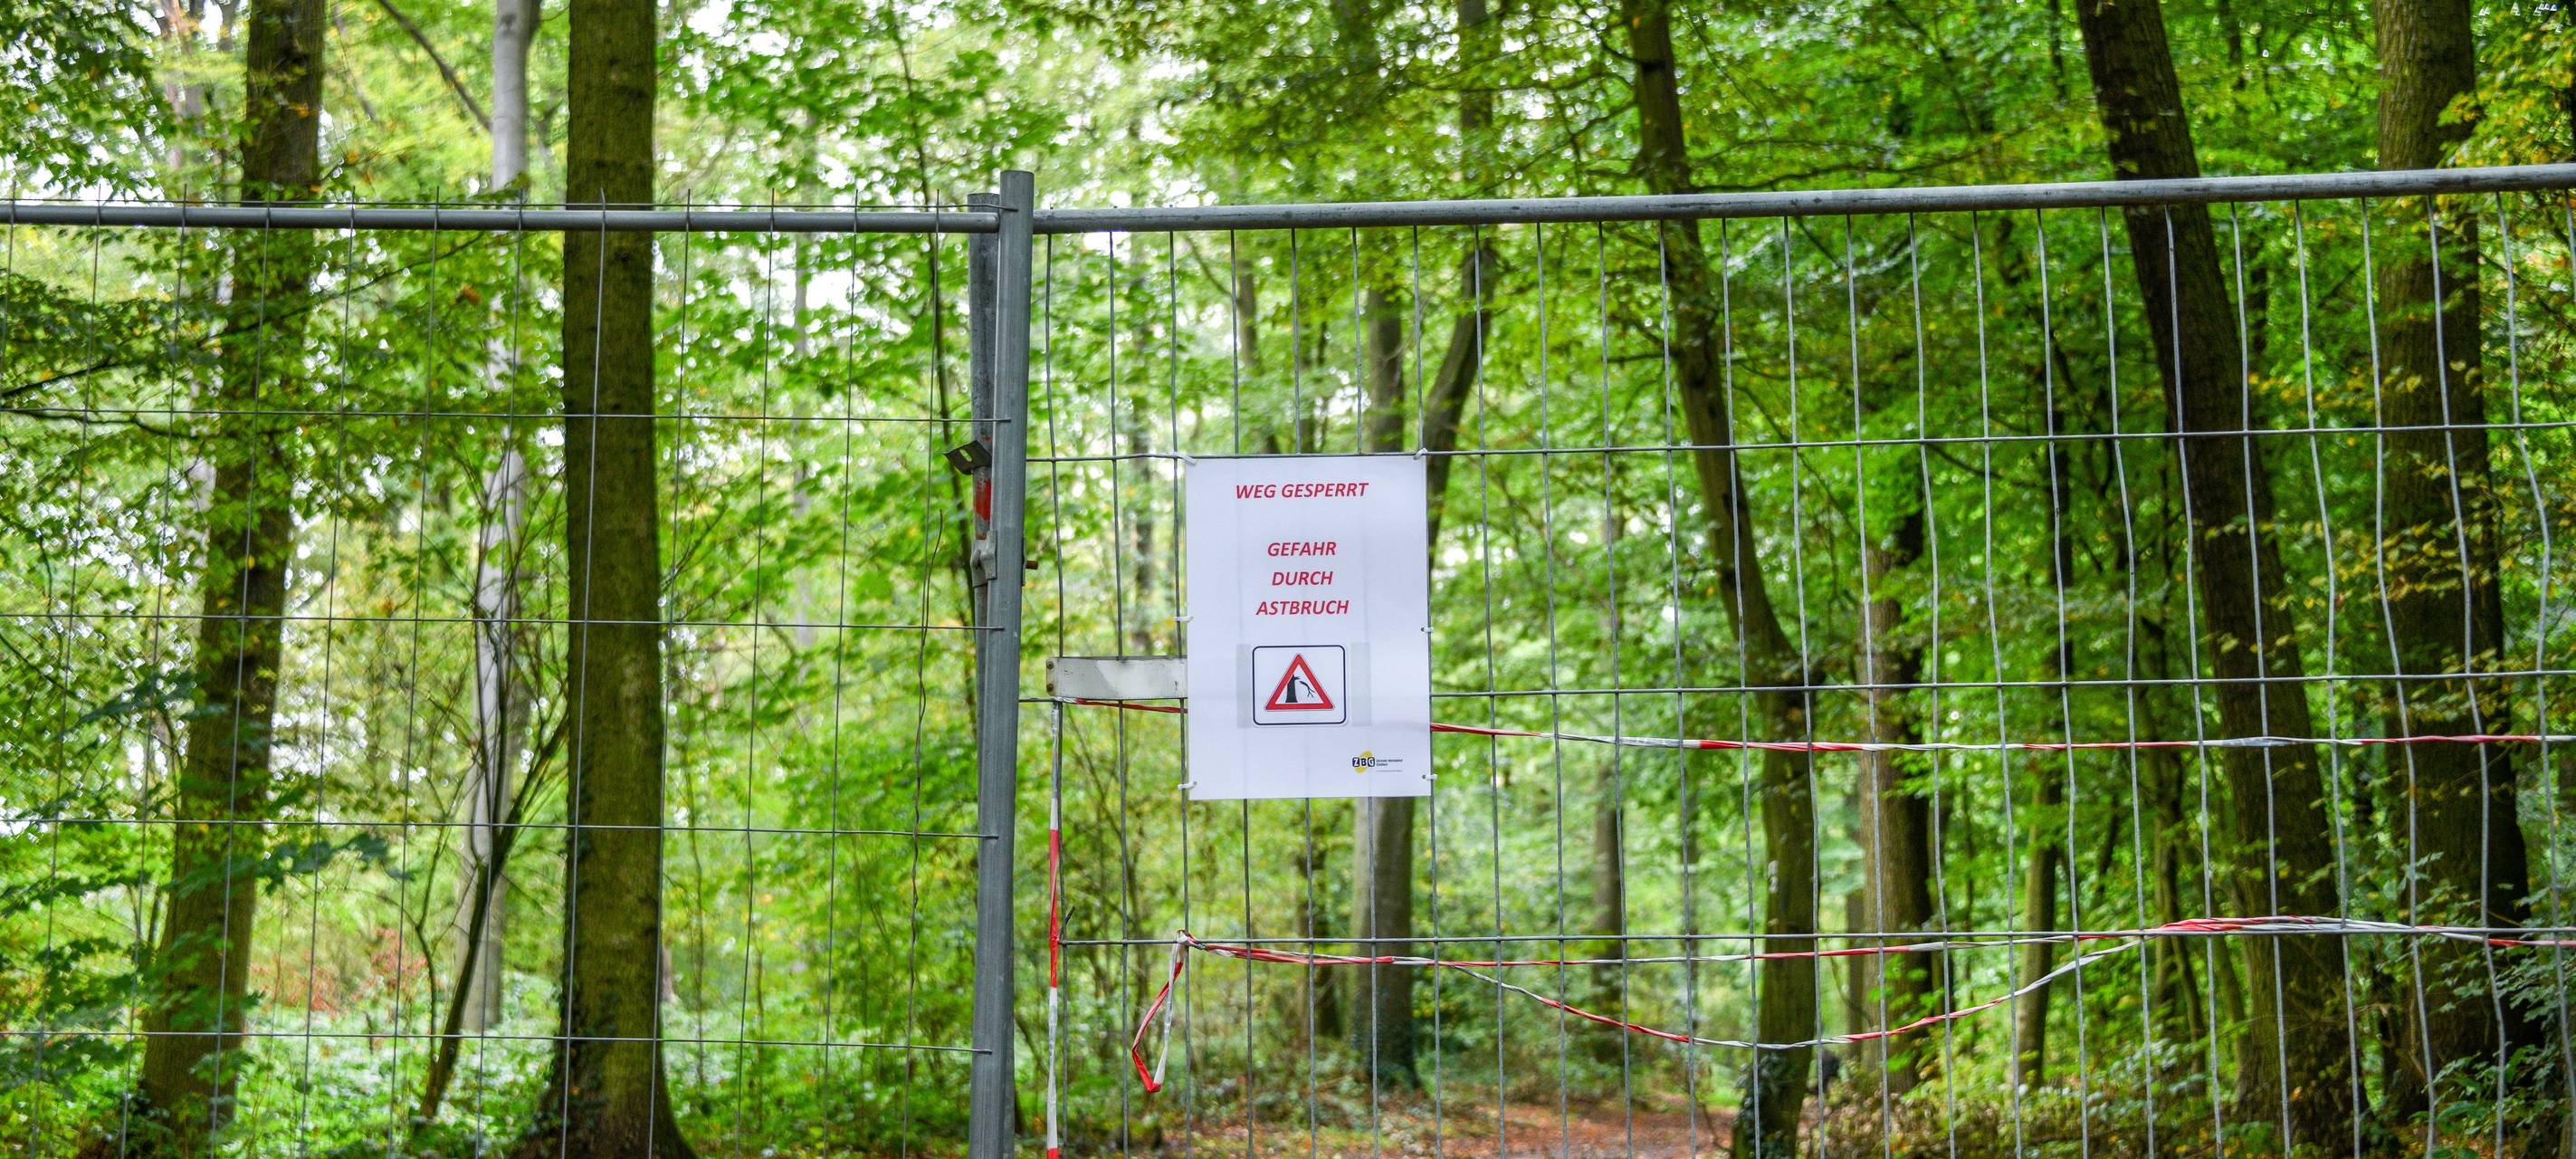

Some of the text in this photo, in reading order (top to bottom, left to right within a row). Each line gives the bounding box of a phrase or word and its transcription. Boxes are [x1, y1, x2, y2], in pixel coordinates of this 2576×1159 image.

[1236, 482, 1369, 500] WEG GESPERRT
[1266, 540, 1338, 558] GEFAHR
[1271, 570, 1333, 587] DURCH
[1256, 599, 1350, 617] ASTBRUCH
[1352, 757, 1375, 768] ZBG
